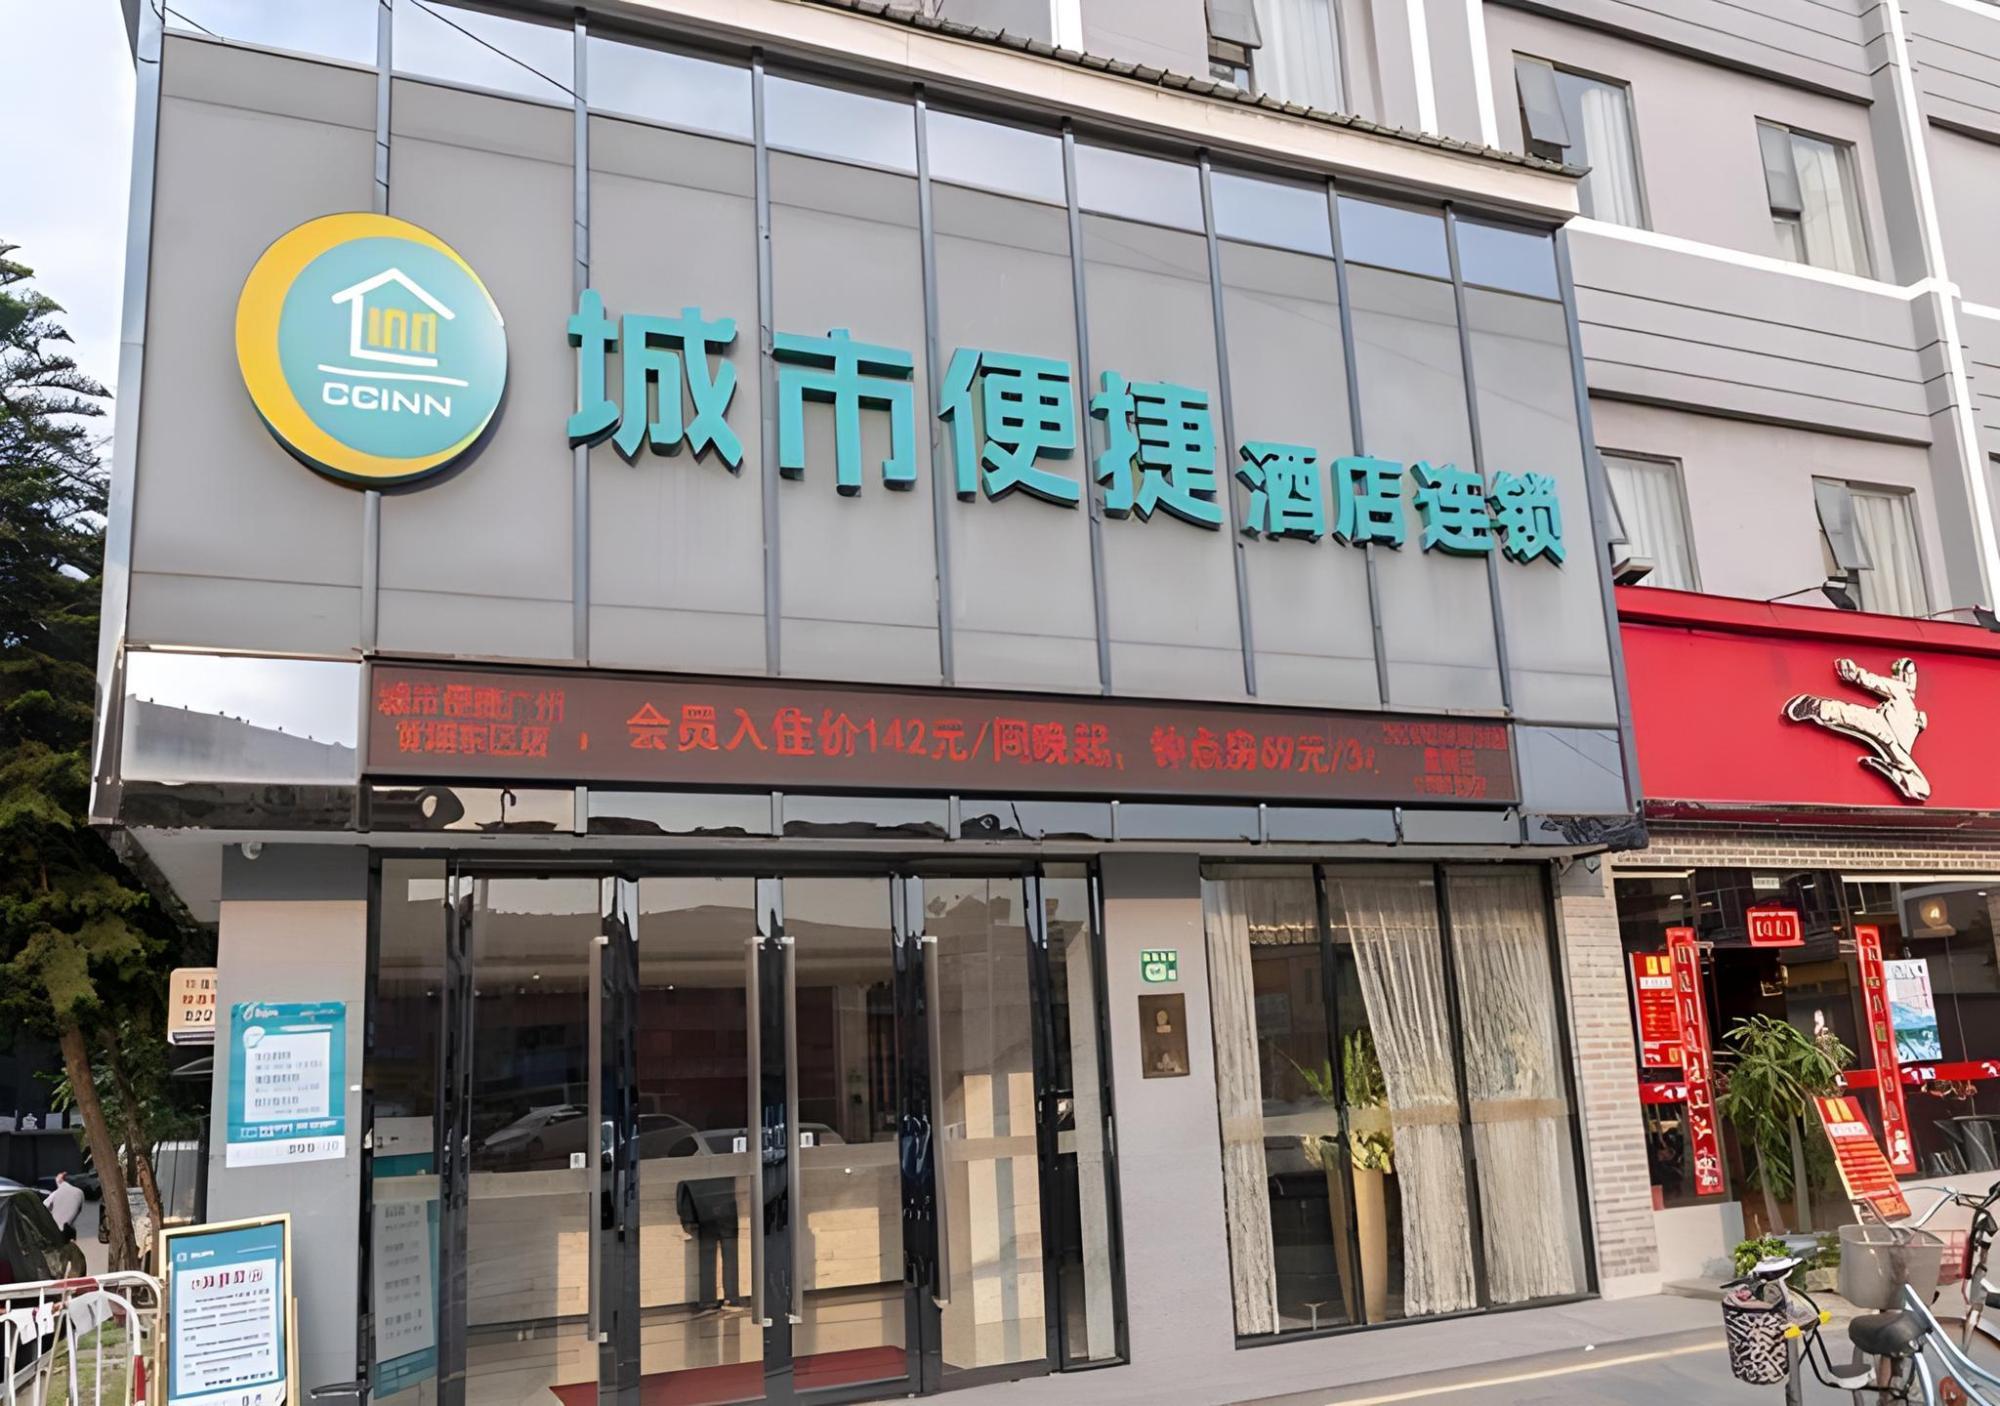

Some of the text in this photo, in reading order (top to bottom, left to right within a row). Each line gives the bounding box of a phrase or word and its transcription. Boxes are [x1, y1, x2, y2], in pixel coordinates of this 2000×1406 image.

[322, 381, 452, 418] CCINN
[567, 289, 1567, 568] 城市便捷 酒店连锁
